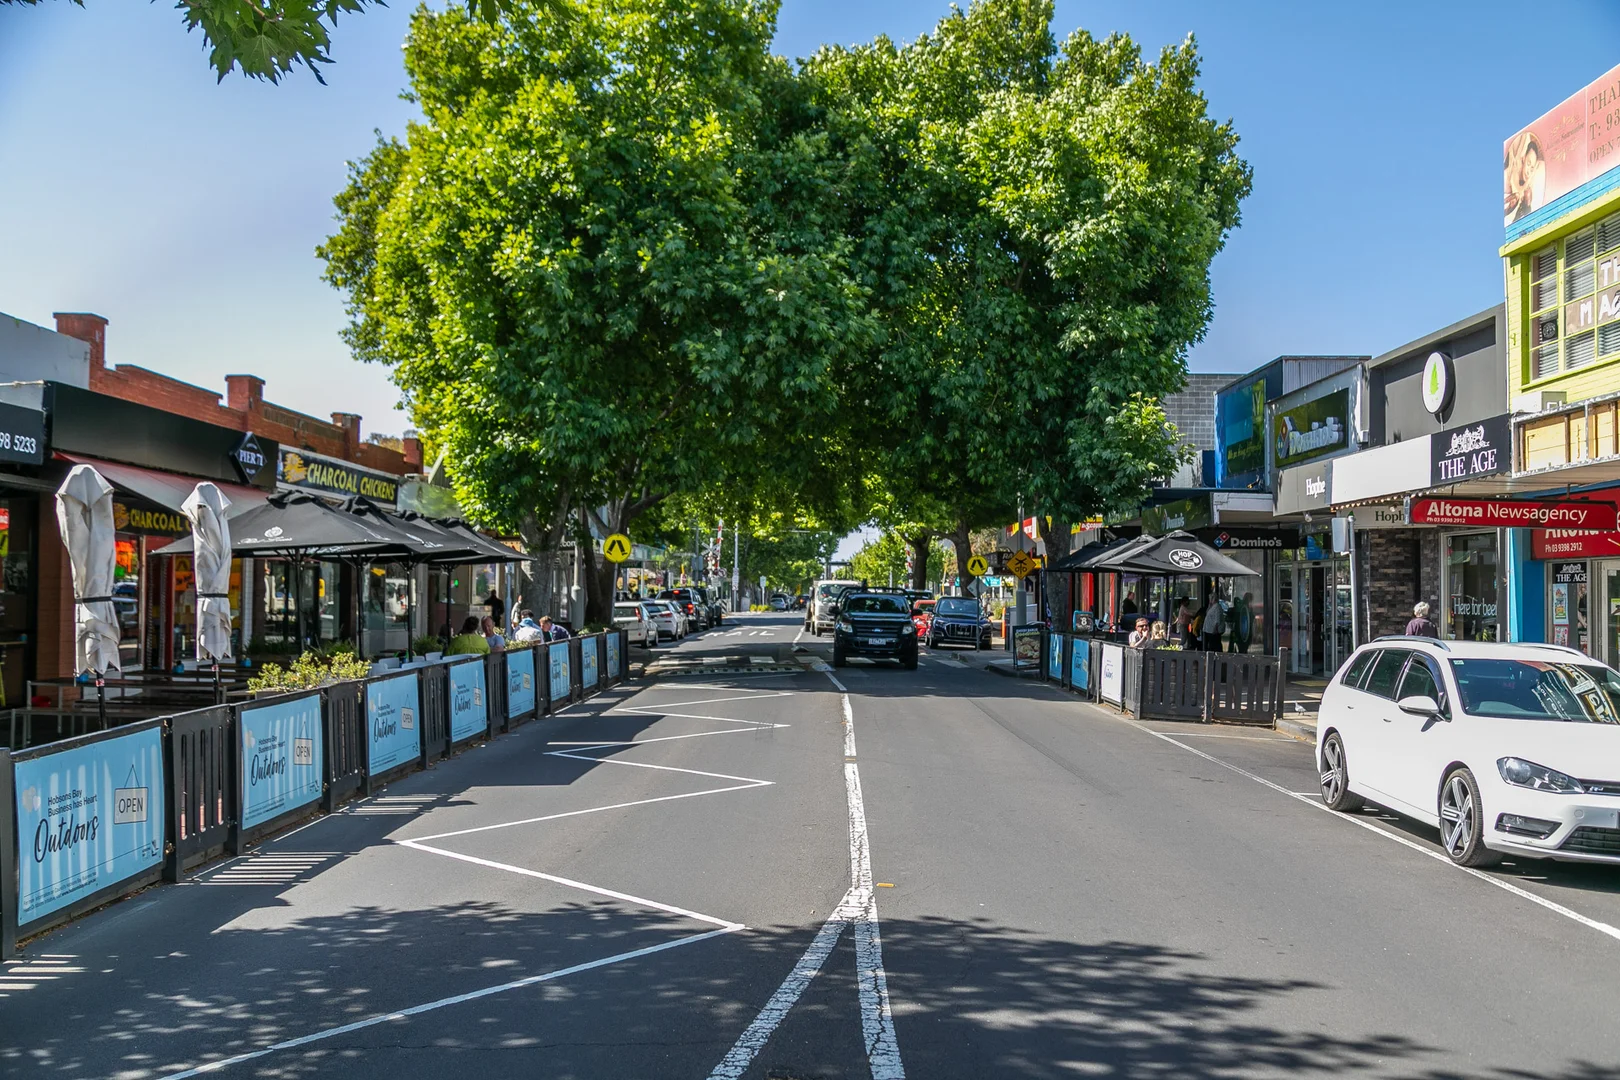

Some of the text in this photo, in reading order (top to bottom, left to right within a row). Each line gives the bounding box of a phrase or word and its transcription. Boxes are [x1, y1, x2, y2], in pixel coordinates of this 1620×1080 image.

[1589, 141, 1614, 163] OPEN
[13, 435, 37, 454] 5233
[239, 449, 257, 465] PIER
[1438, 449, 1497, 480] THE AGE
[307, 463, 396, 501] CHARCOAL CHICKENS
[130, 508, 183, 532] CHARCOAL
[1427, 501, 1588, 524] Altona Newsagency
[1230, 537, 1282, 547] Domino's
[1545, 542, 1582, 553] Ph 03 9398 2912
[1556, 574, 1571, 582] THE
[1453, 598, 1470, 614] Here
[1471, 597, 1481, 615] for
[296, 745, 310, 758] OPEN
[251, 753, 285, 786] Outdoors
[48, 789, 82, 806] Hobsons Bay
[48, 794, 98, 817] Business has Heart
[118, 797, 143, 814] OPEN
[34, 814, 99, 863] Outdoors
